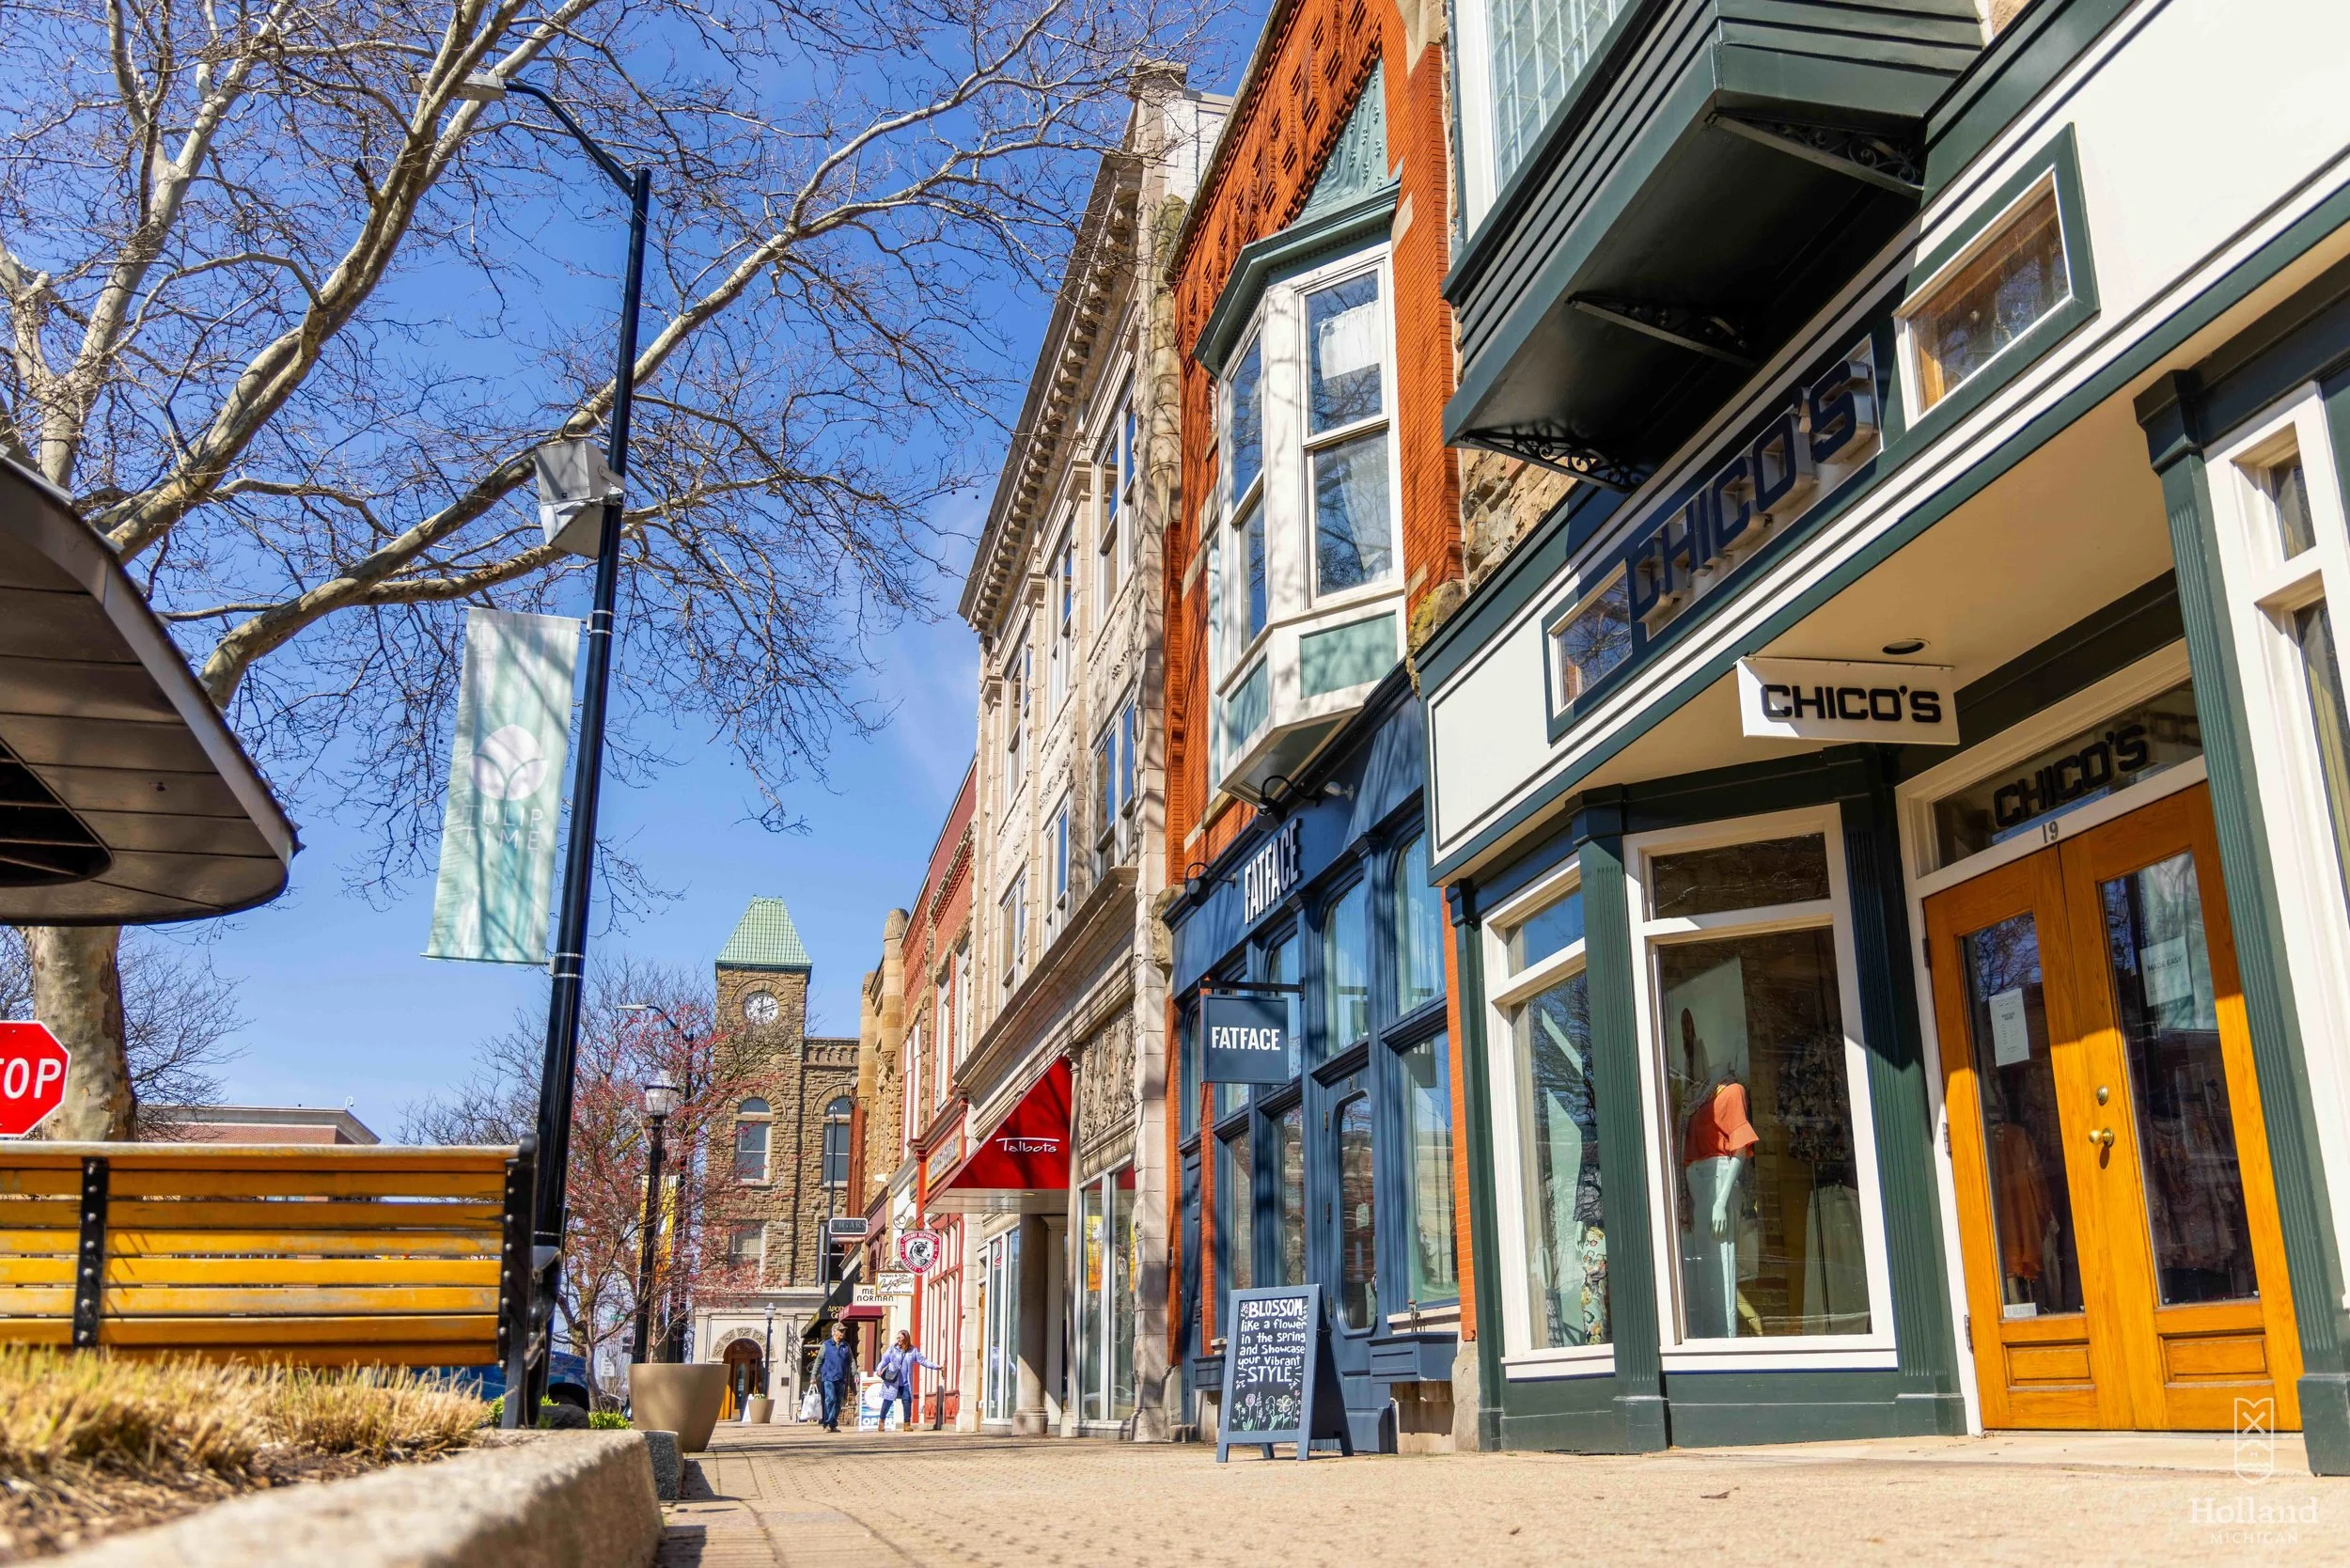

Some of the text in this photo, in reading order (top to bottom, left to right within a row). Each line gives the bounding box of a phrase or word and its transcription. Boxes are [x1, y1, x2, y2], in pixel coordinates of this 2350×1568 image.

[1627, 360, 1860, 622] CHICO'S
[1761, 684, 1942, 723] CHICO'S
[1993, 724, 2149, 828] CHICO'S
[463, 804, 543, 827] TULIP
[458, 826, 540, 850] TIME
[2041, 821, 2059, 844] 19
[1244, 818, 1299, 925] FATFACE
[1212, 1027, 1281, 1051] FATFACE
[0, 1058, 62, 1099] OP
[996, 1137, 1060, 1152] Talbots
[831, 1220, 867, 1229] CIGARS
[1248, 1298, 1303, 1318] BLOSSOM
[1263, 1320, 1270, 1329] a
[1274, 1319, 1307, 1329] flower
[1241, 1334, 1251, 1344] in
[1257, 1332, 1273, 1343] the
[1239, 1344, 1306, 1356] and Showcase
[1237, 1356, 1261, 1369] your
[1247, 1366, 1292, 1383] STYLE
[862, 1418, 895, 1426] OPN
